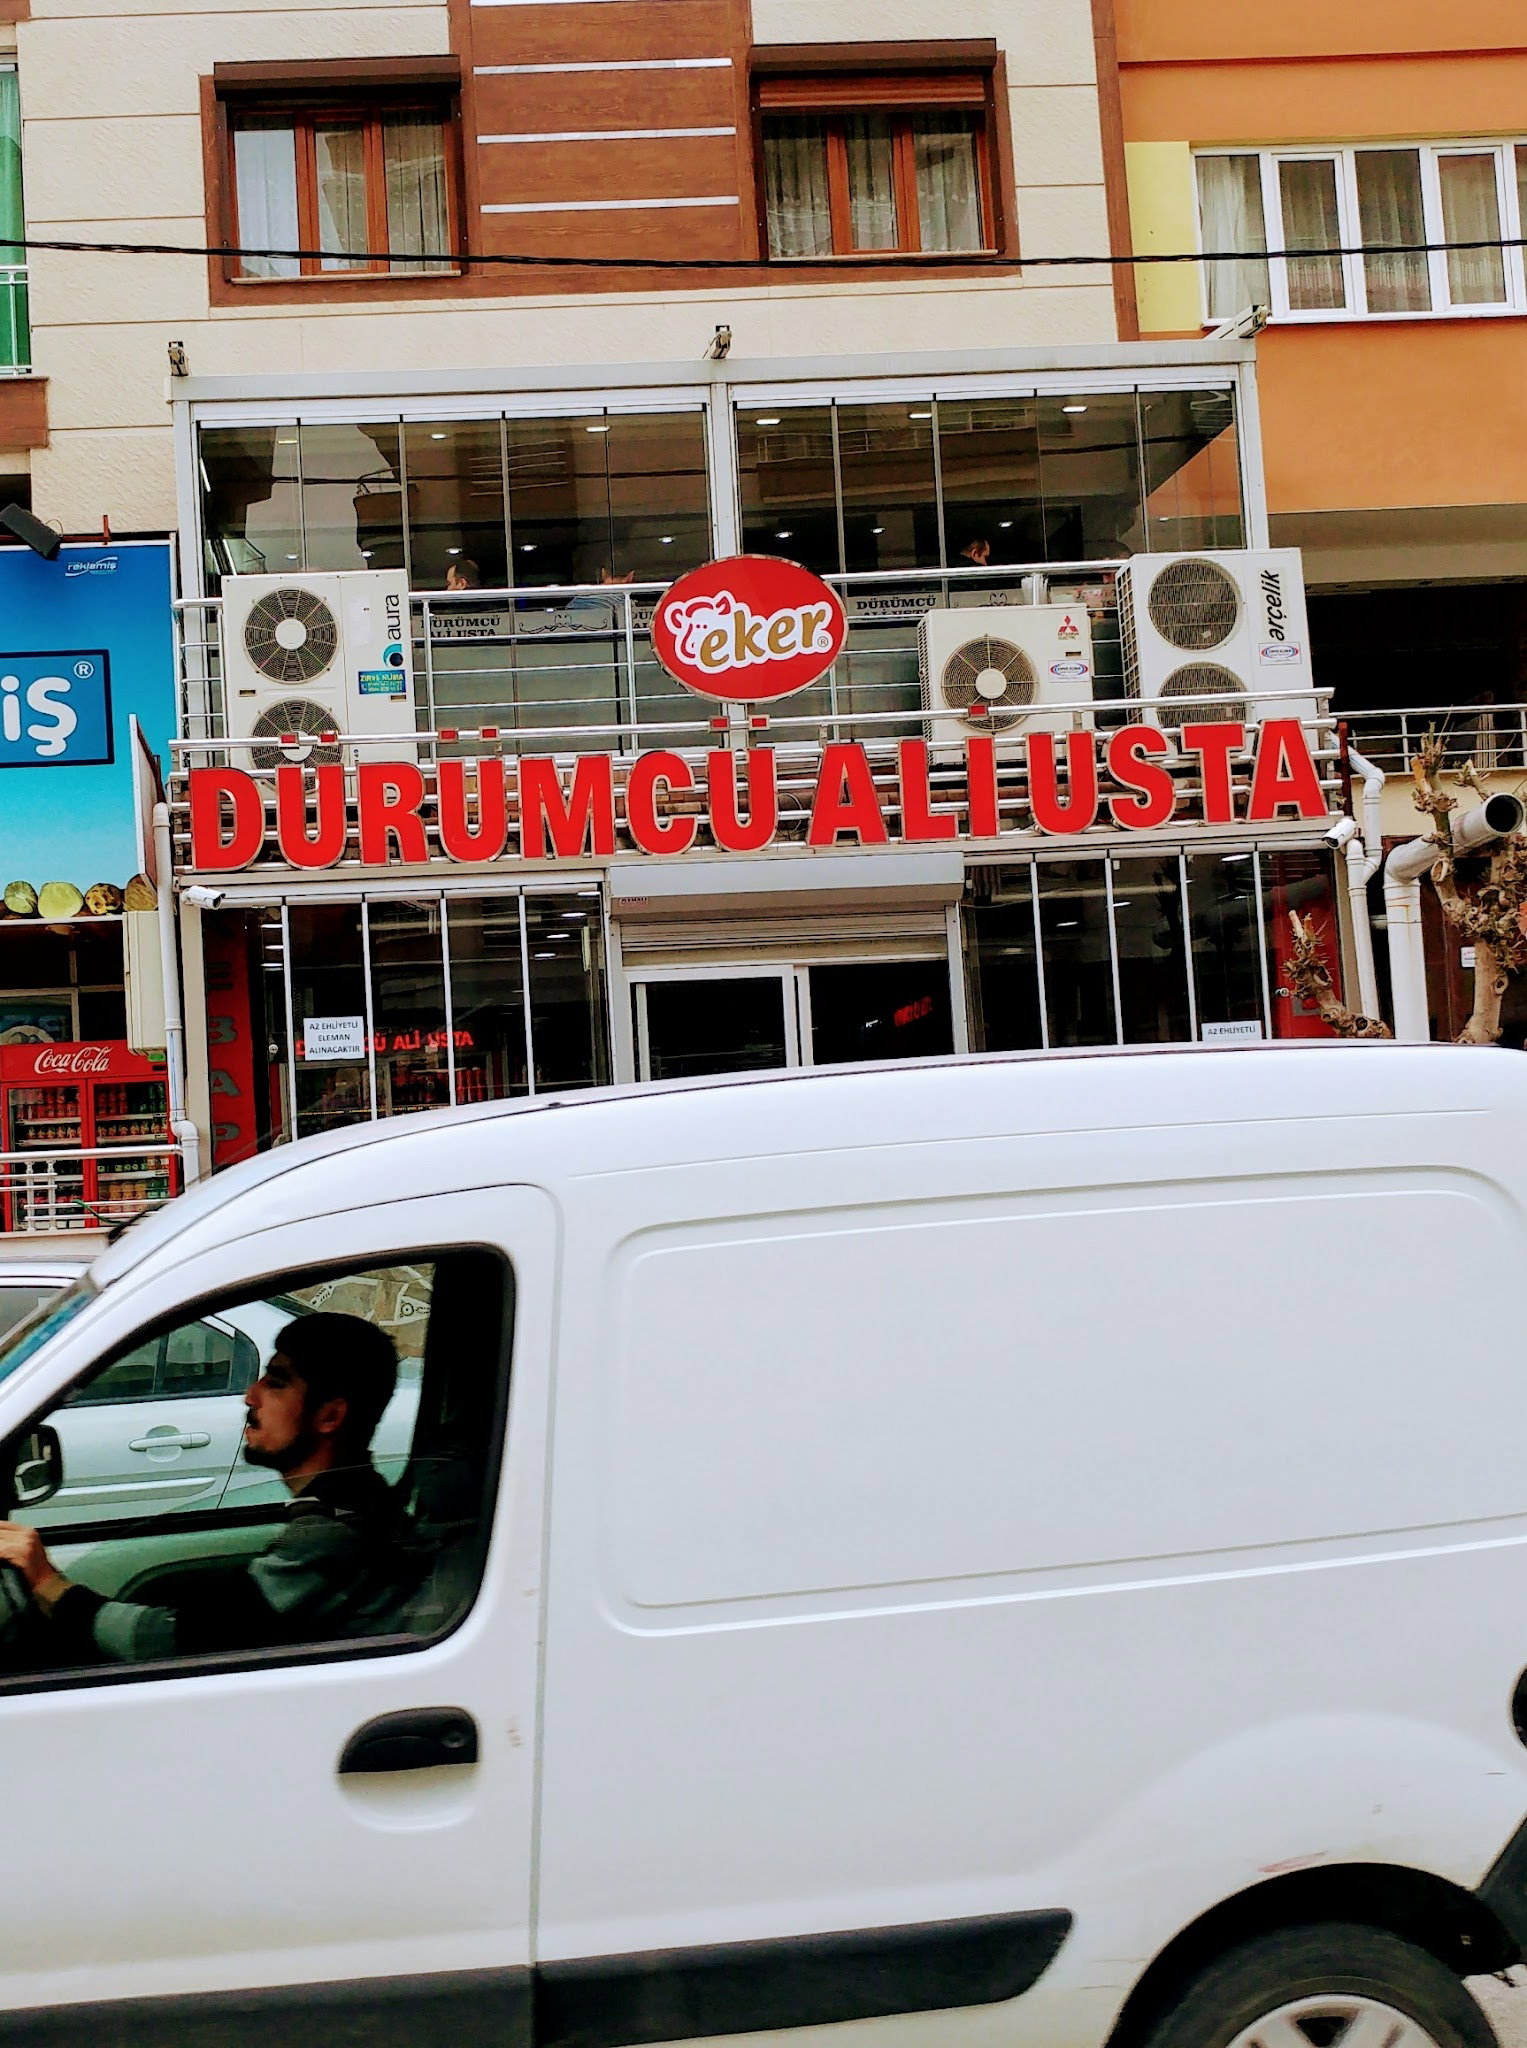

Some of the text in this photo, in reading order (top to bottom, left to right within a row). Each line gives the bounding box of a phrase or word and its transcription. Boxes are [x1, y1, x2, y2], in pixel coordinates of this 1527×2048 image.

[385, 593, 402, 640] aura
[856, 595, 936, 610] DÜRÜMCÜ
[1260, 570, 1287, 641] arçelik
[700, 609, 826, 667] eker
[189, 714, 779, 873] DÜRÜMCÜ
[1025, 717, 1329, 836] USTA
[309, 1045, 361, 1054] ALINACAKTIR
[318, 1034, 350, 1042] ELEMAN
